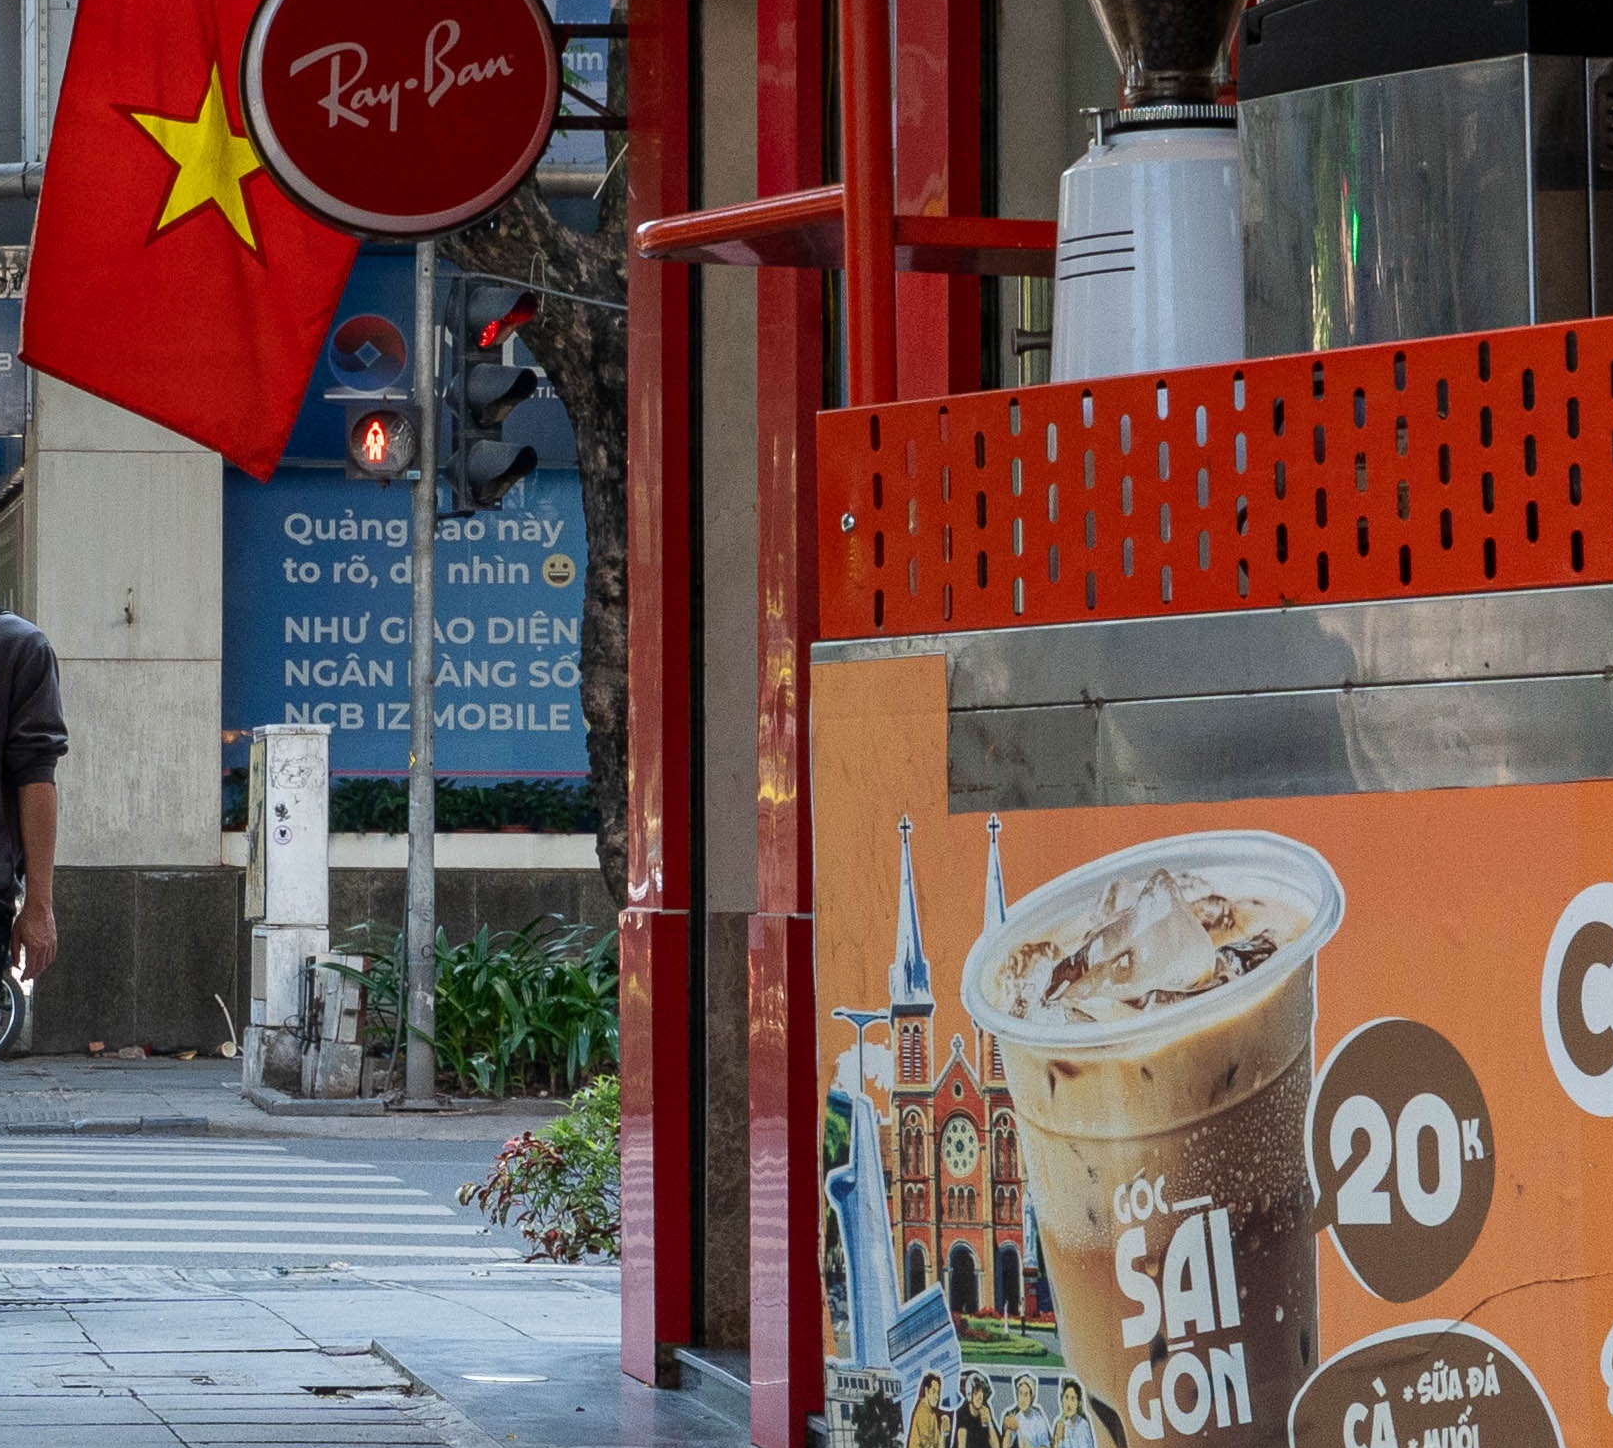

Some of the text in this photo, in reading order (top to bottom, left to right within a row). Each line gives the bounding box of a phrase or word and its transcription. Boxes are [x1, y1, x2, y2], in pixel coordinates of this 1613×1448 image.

[284, 509, 408, 546] Quảng
[497, 513, 564, 547] này
[283, 557, 321, 584] to
[448, 555, 530, 585] nhìn
[284, 611, 371, 644] NHƯ
[487, 610, 578, 652] DIỆN
[284, 653, 394, 688] NGÂN
[529, 651, 582, 689] SỐ
[284, 703, 364, 731] NCB
[1113, 1167, 1169, 1224] GÓC
[1417, 1352, 1501, 1404] SỮA ĐÁ
